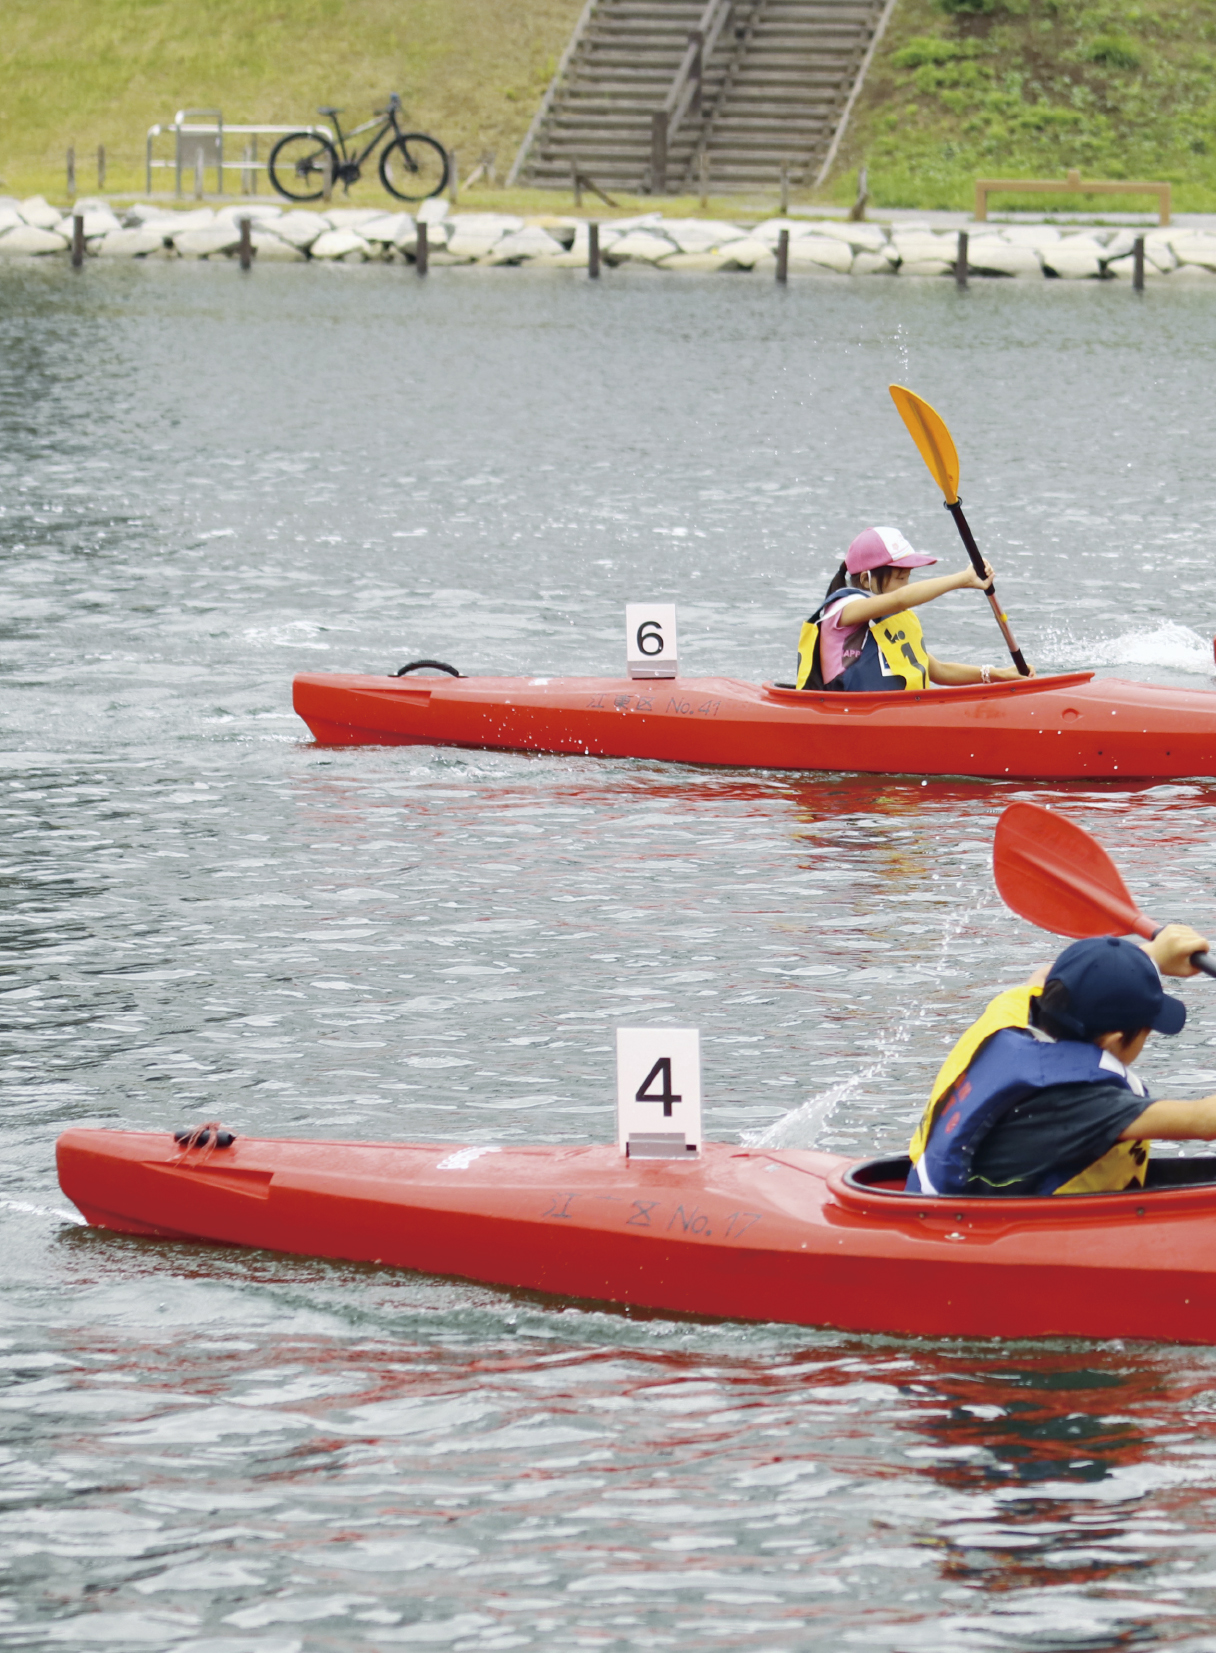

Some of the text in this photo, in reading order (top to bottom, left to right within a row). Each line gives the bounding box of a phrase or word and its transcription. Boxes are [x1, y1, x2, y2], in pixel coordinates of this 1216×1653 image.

[636, 620, 664, 656] 6
[843, 649, 862, 658] APP
[586, 693, 656, 712] 江東区
[635, 1057, 682, 1117] 4
